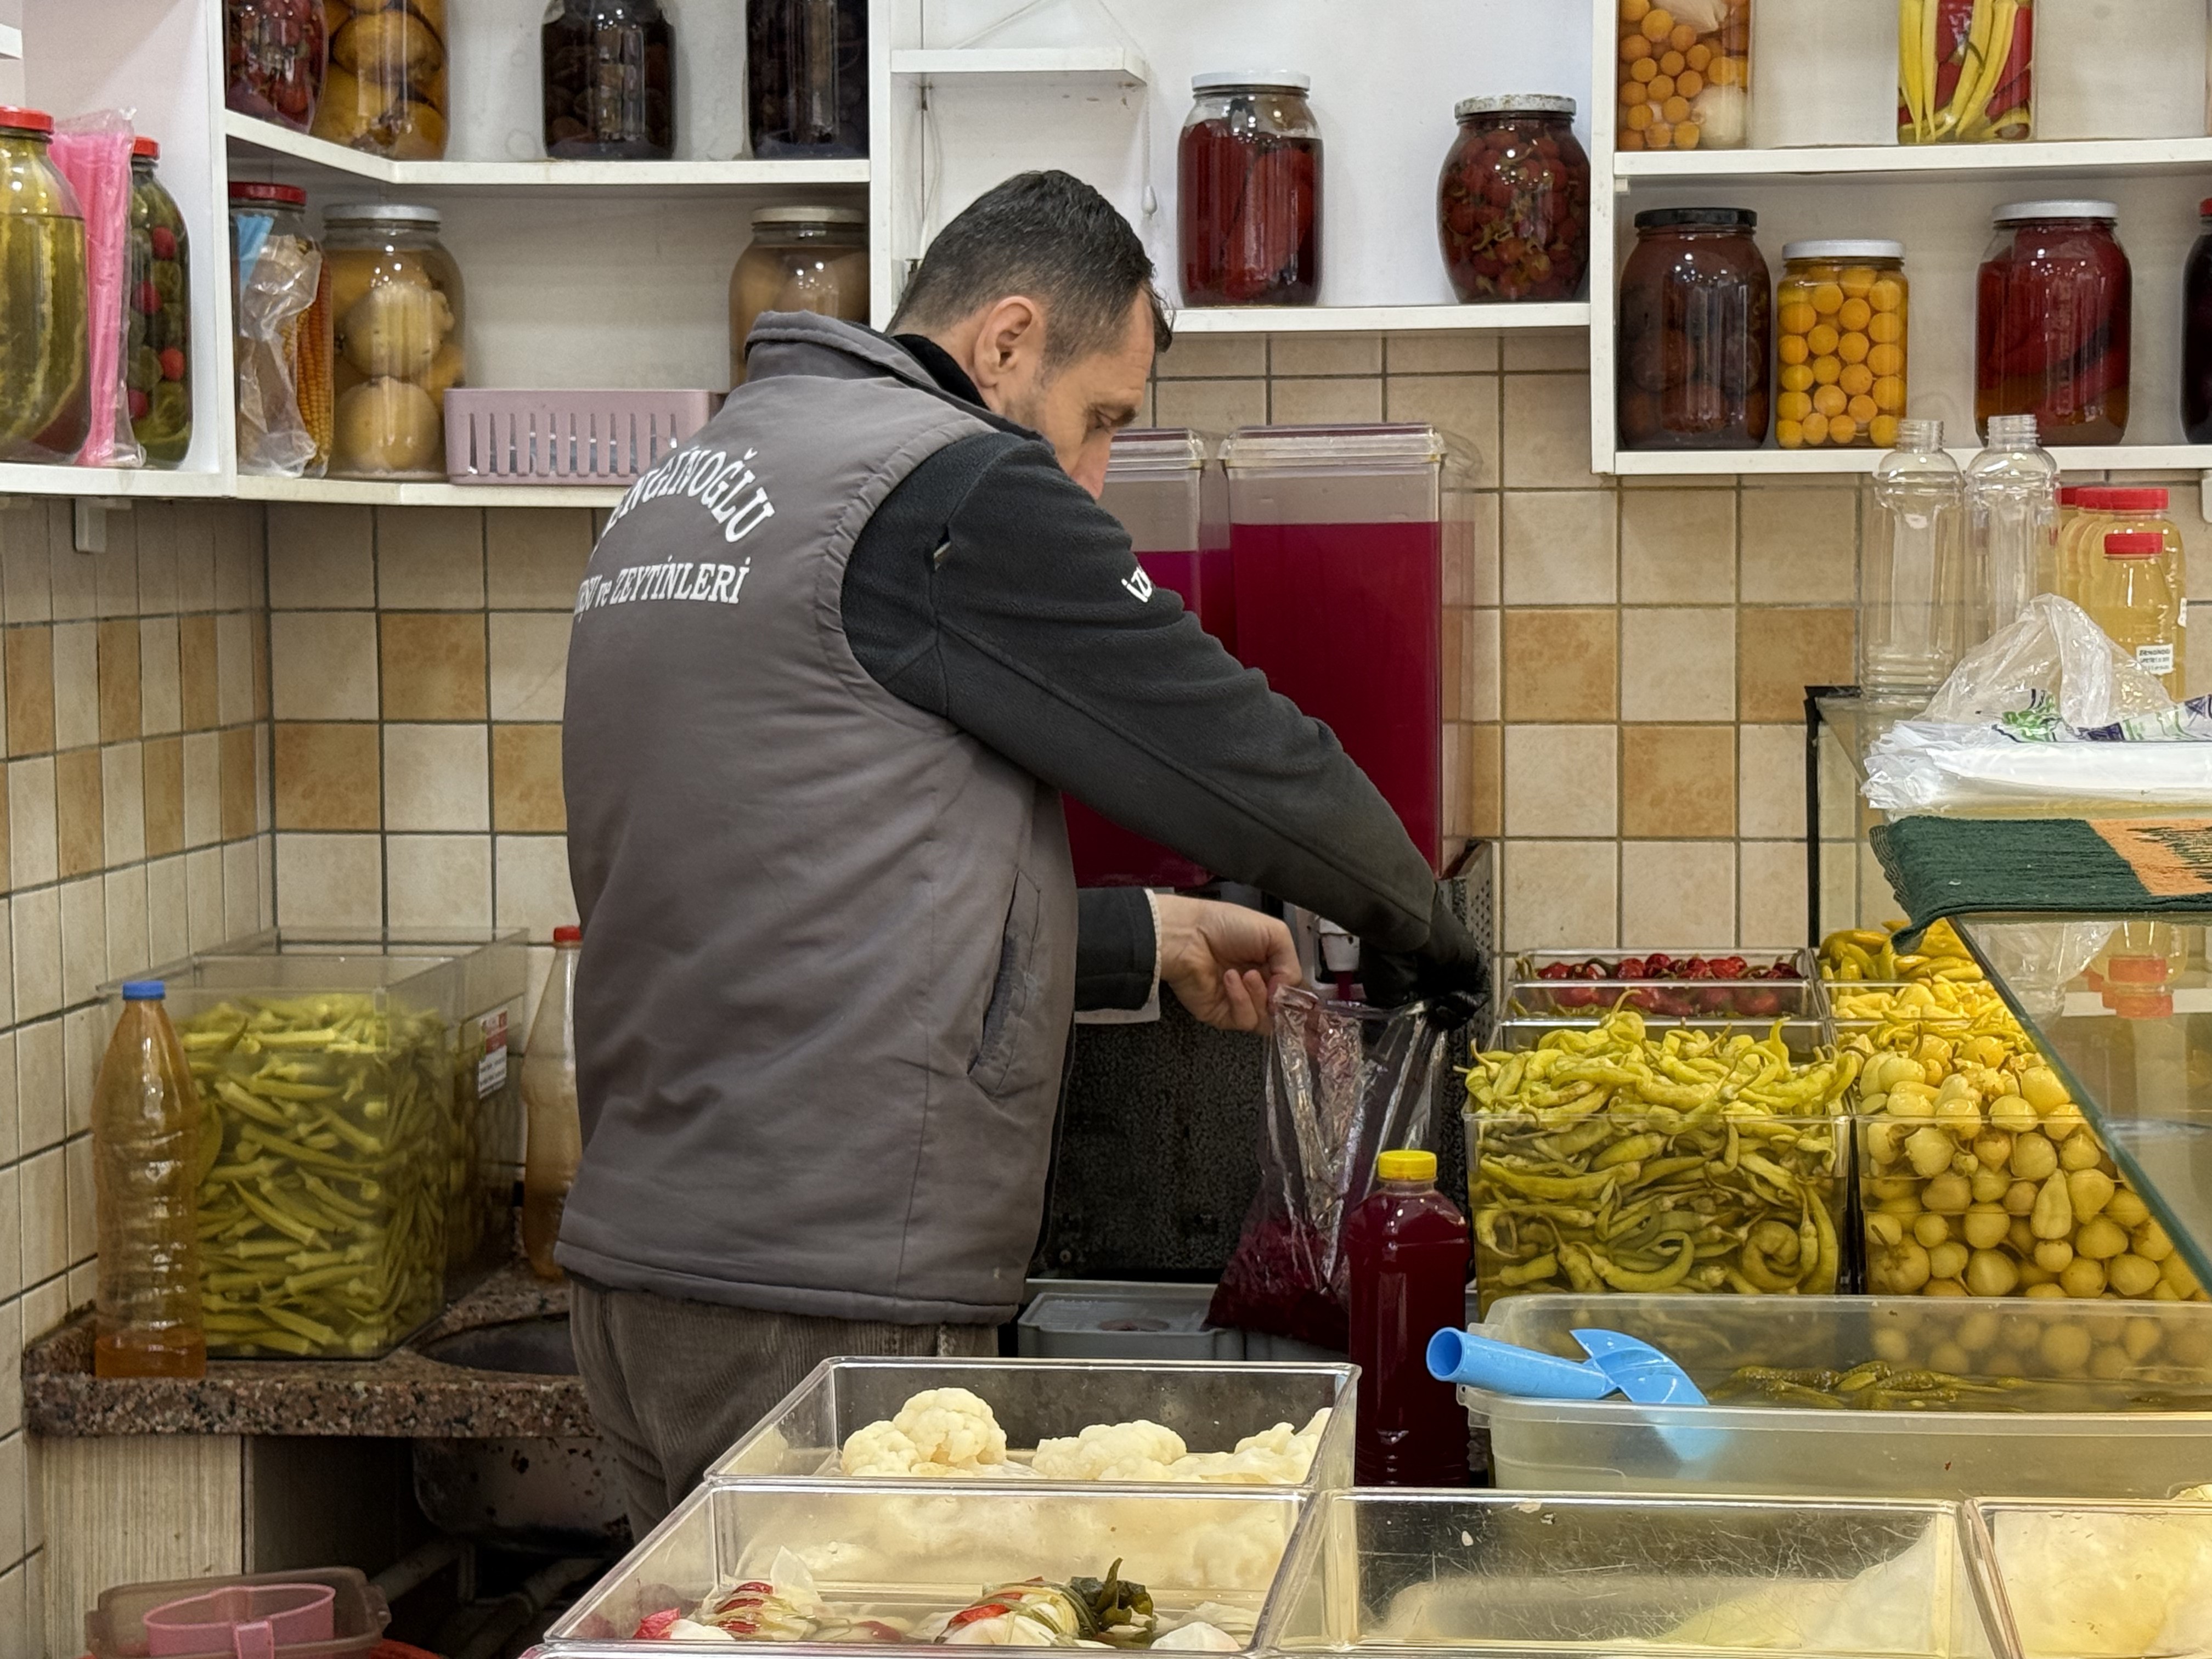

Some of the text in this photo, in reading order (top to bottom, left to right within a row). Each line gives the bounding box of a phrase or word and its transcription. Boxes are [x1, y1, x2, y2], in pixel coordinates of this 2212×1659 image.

[590, 445, 775, 561] ENGİNOĞLU
[609, 555, 751, 605] ZEYTİNLERİ
[1121, 563, 1153, 603] İZ
